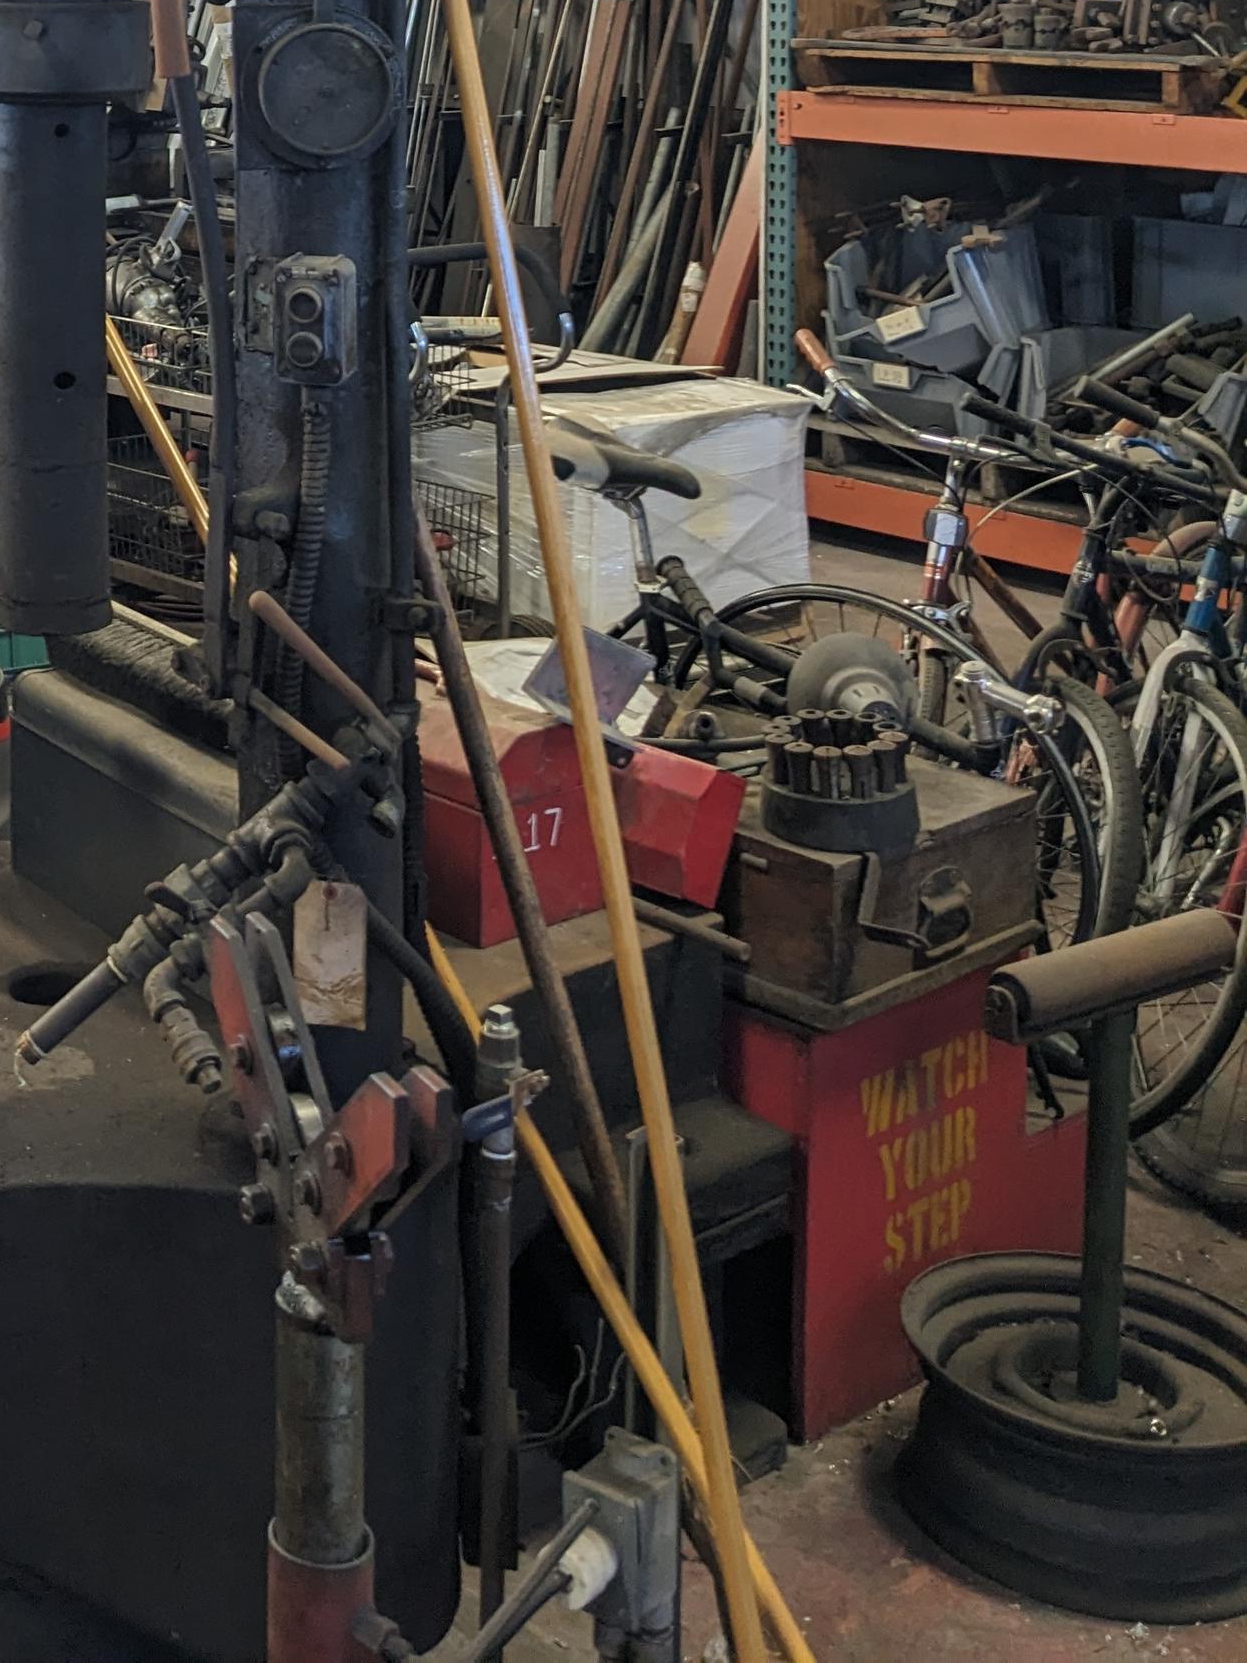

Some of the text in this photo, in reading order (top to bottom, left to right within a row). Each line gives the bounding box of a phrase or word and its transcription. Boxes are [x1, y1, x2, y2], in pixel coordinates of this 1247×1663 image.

[860, 1029, 989, 1138] WATCH
[880, 1106, 976, 1201] YOUR
[884, 1178, 971, 1274] STEP
